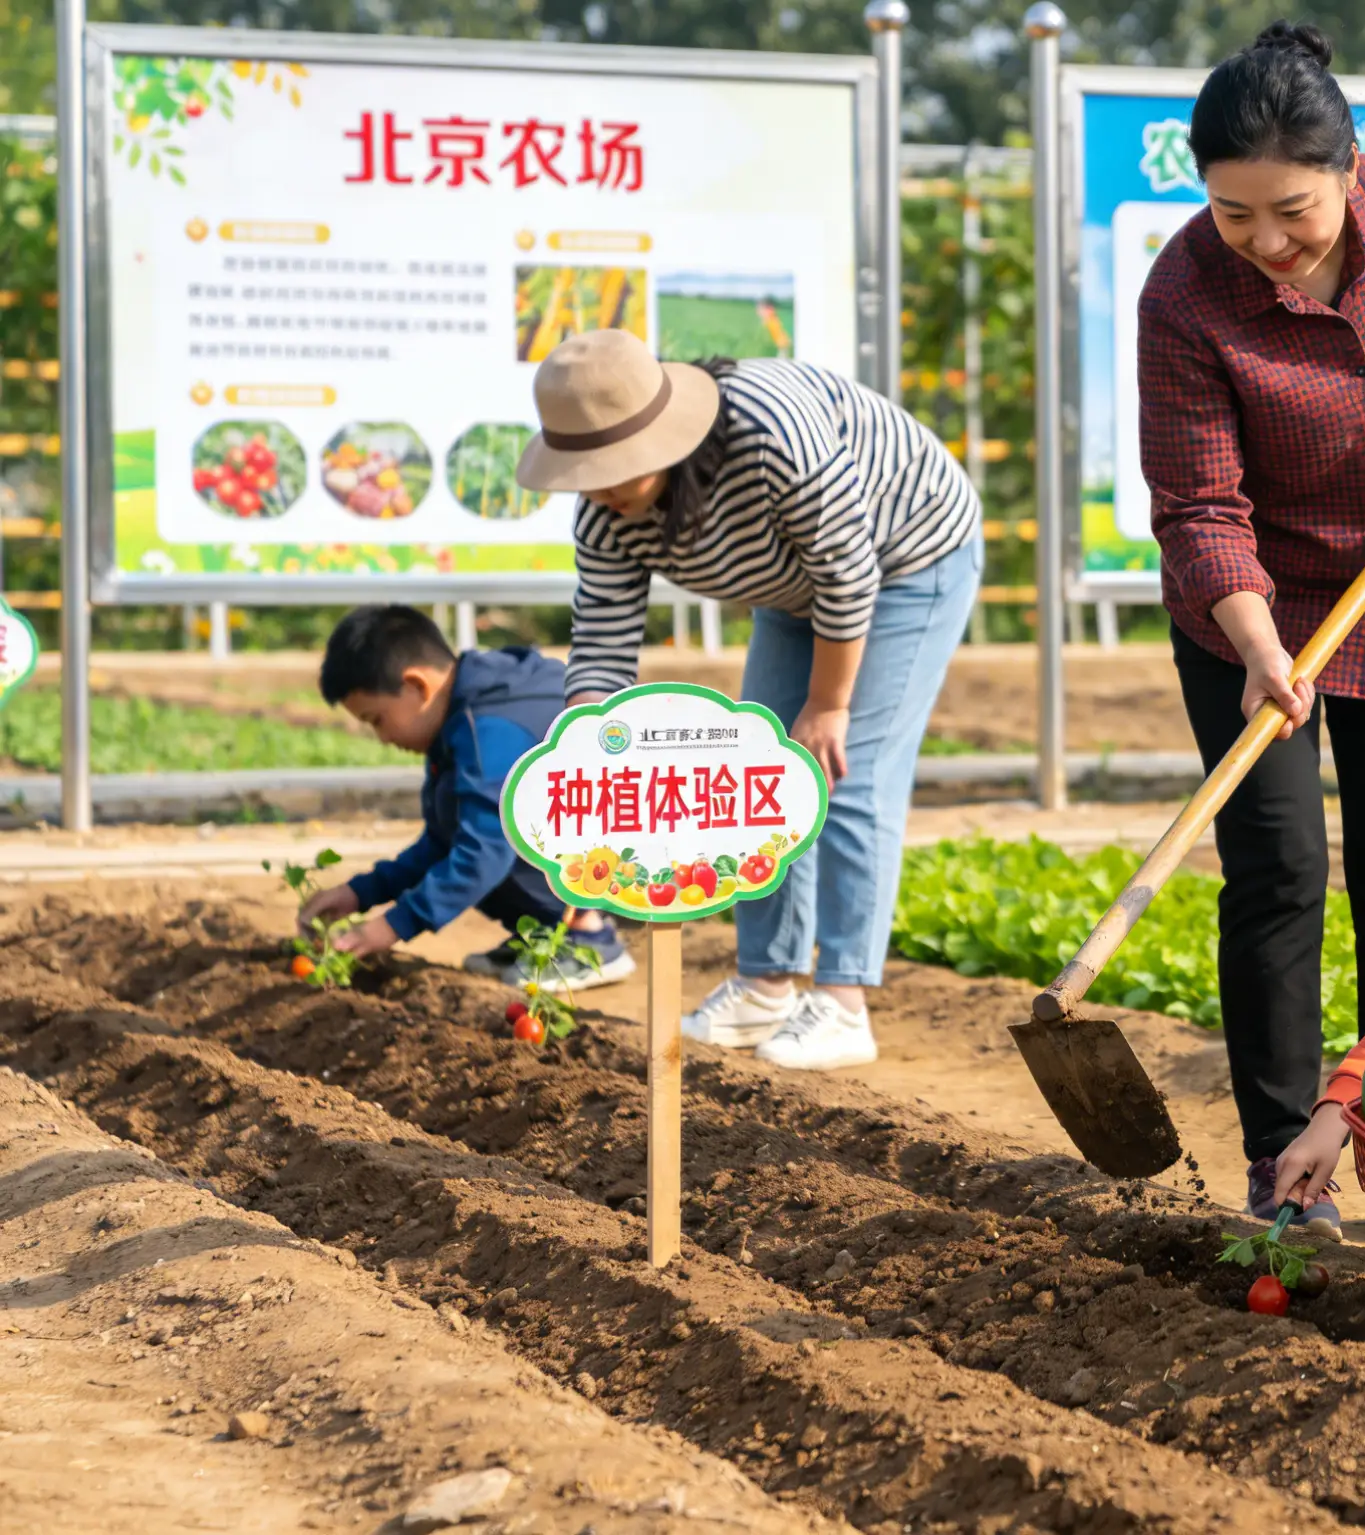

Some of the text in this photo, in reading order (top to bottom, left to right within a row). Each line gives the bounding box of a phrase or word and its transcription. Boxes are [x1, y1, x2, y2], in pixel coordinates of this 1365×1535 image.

[343, 111, 644, 192] 北京农场
[546, 763, 786, 837] 种植体验区
